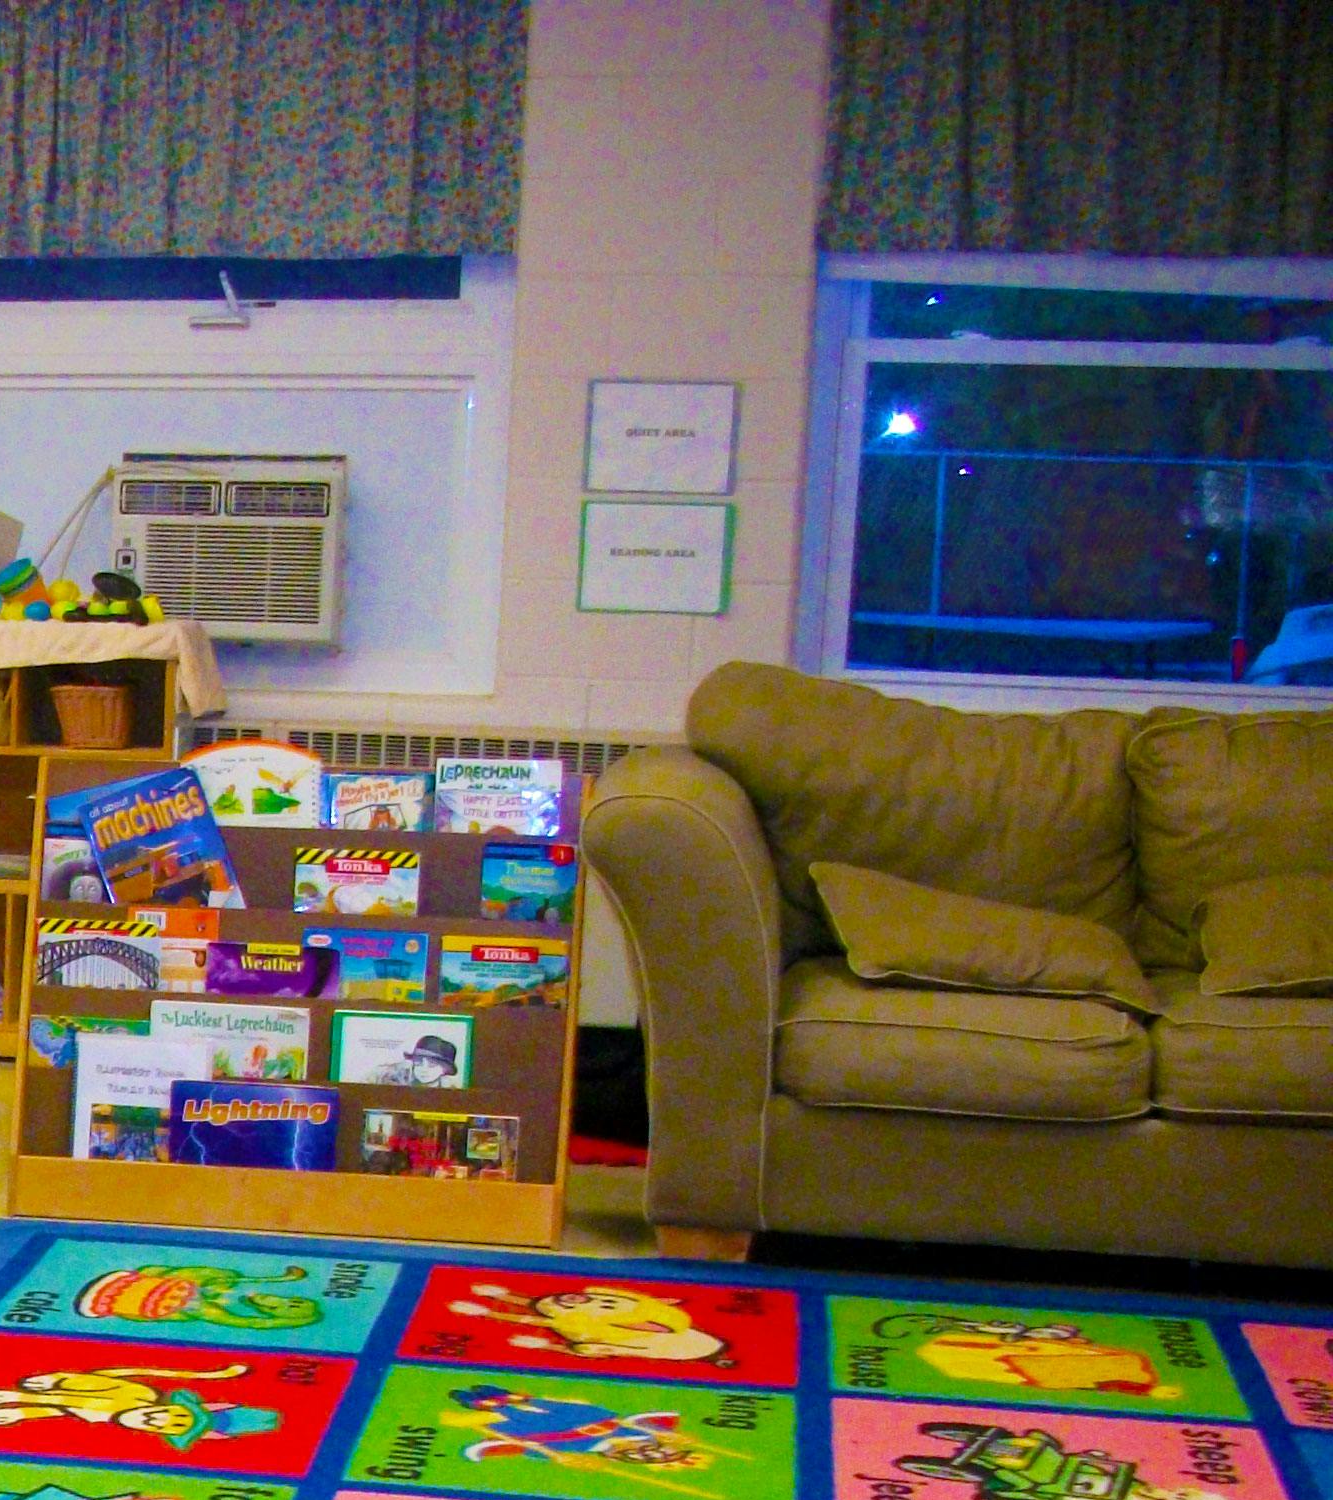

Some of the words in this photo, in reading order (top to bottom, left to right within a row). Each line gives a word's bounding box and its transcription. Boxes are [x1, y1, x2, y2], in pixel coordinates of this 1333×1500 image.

[664, 428, 696, 438] AREA
[664, 548, 696, 558] AREA
[93, 785, 206, 851] machines
[333, 859, 383, 874] Tonka
[240, 955, 305, 974] Weather
[480, 947, 532, 961] Tonka
[226, 1013, 295, 1035] Leprechaun
[183, 1098, 331, 1126] Lightning
[323, 1261, 371, 1300] snake
[4, 1290, 60, 1324] cake
[1153, 1318, 1208, 1370] mouse
[847, 1345, 900, 1389] house
[703, 1395, 775, 1432] king
[366, 1425, 446, 1480] swing
[1180, 1427, 1240, 1485] sheep
